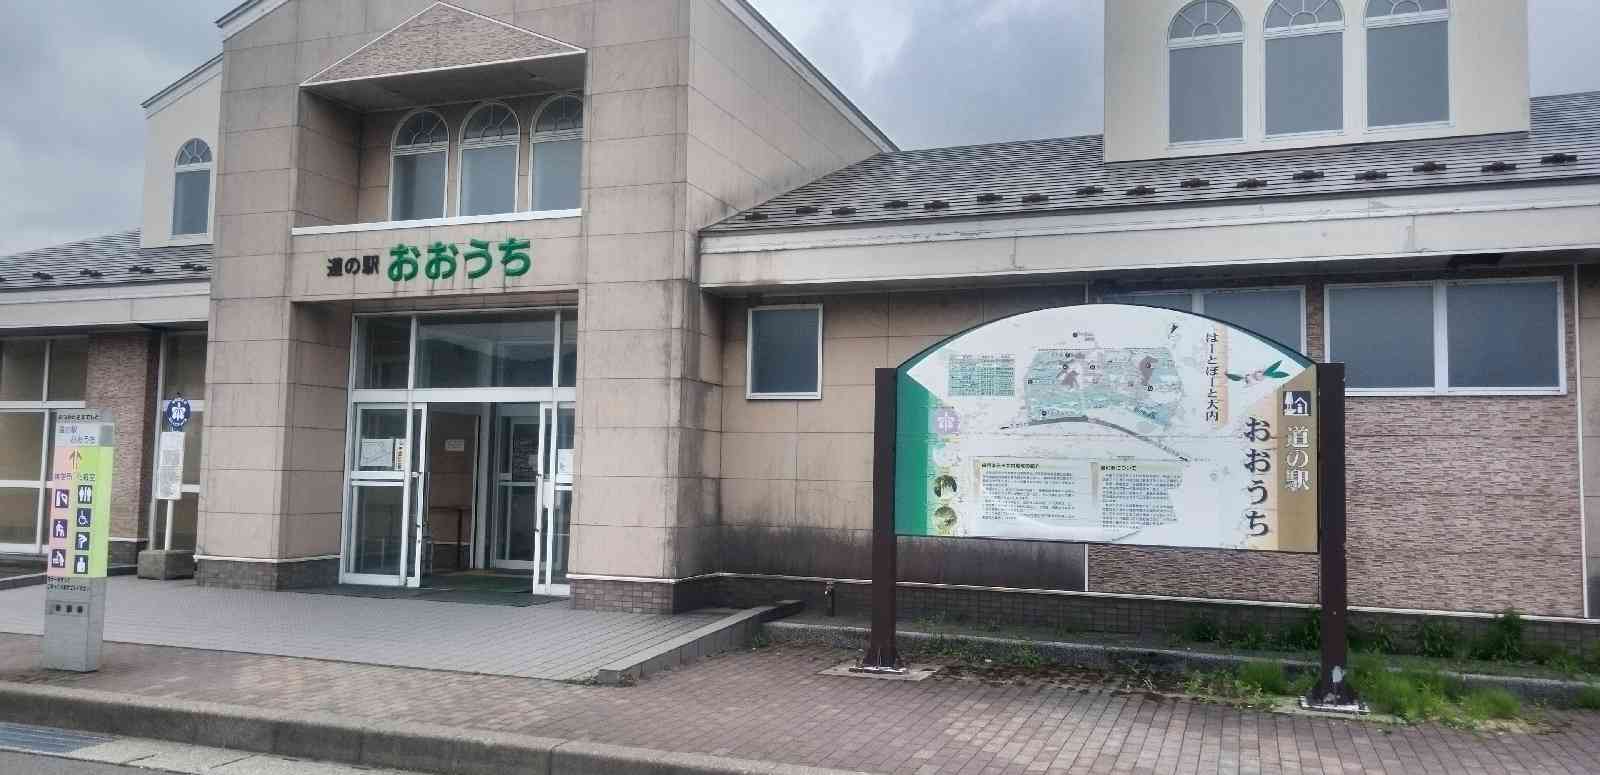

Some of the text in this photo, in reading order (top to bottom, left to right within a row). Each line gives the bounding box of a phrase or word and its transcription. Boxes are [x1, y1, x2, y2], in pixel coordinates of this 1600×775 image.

[326, 238, 532, 282] 道の駅 おおうち
[1244, 417, 1271, 537] おおうち
[1286, 425, 1310, 490] 道の駅
